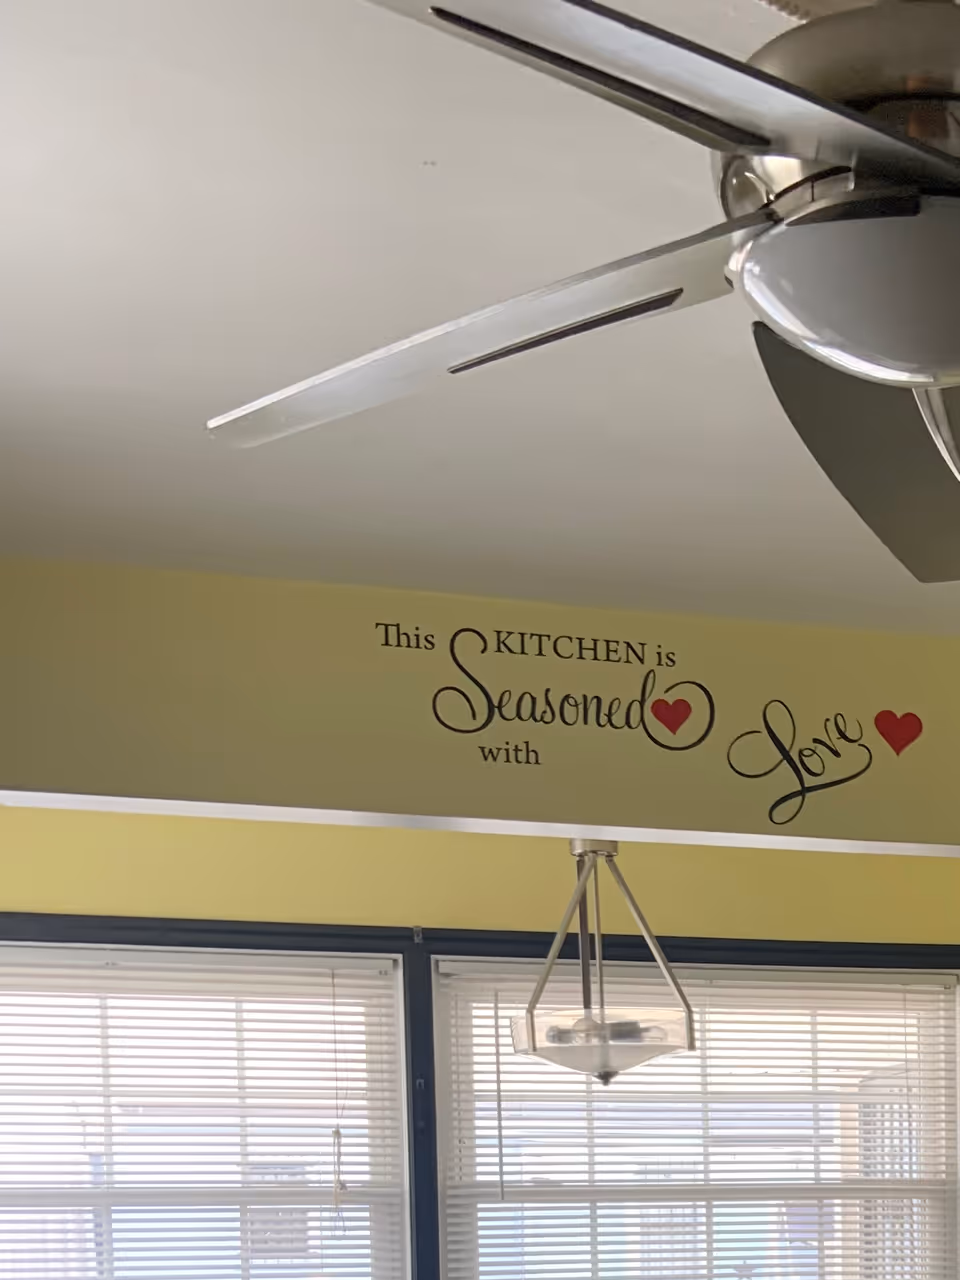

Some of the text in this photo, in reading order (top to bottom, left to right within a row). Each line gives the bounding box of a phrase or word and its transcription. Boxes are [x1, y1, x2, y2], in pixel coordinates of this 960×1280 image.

[375, 622, 677, 668] This KITCHEN is
[432, 627, 715, 751] Seasoned
[478, 740, 543, 767] with
[727, 699, 873, 825] Love
